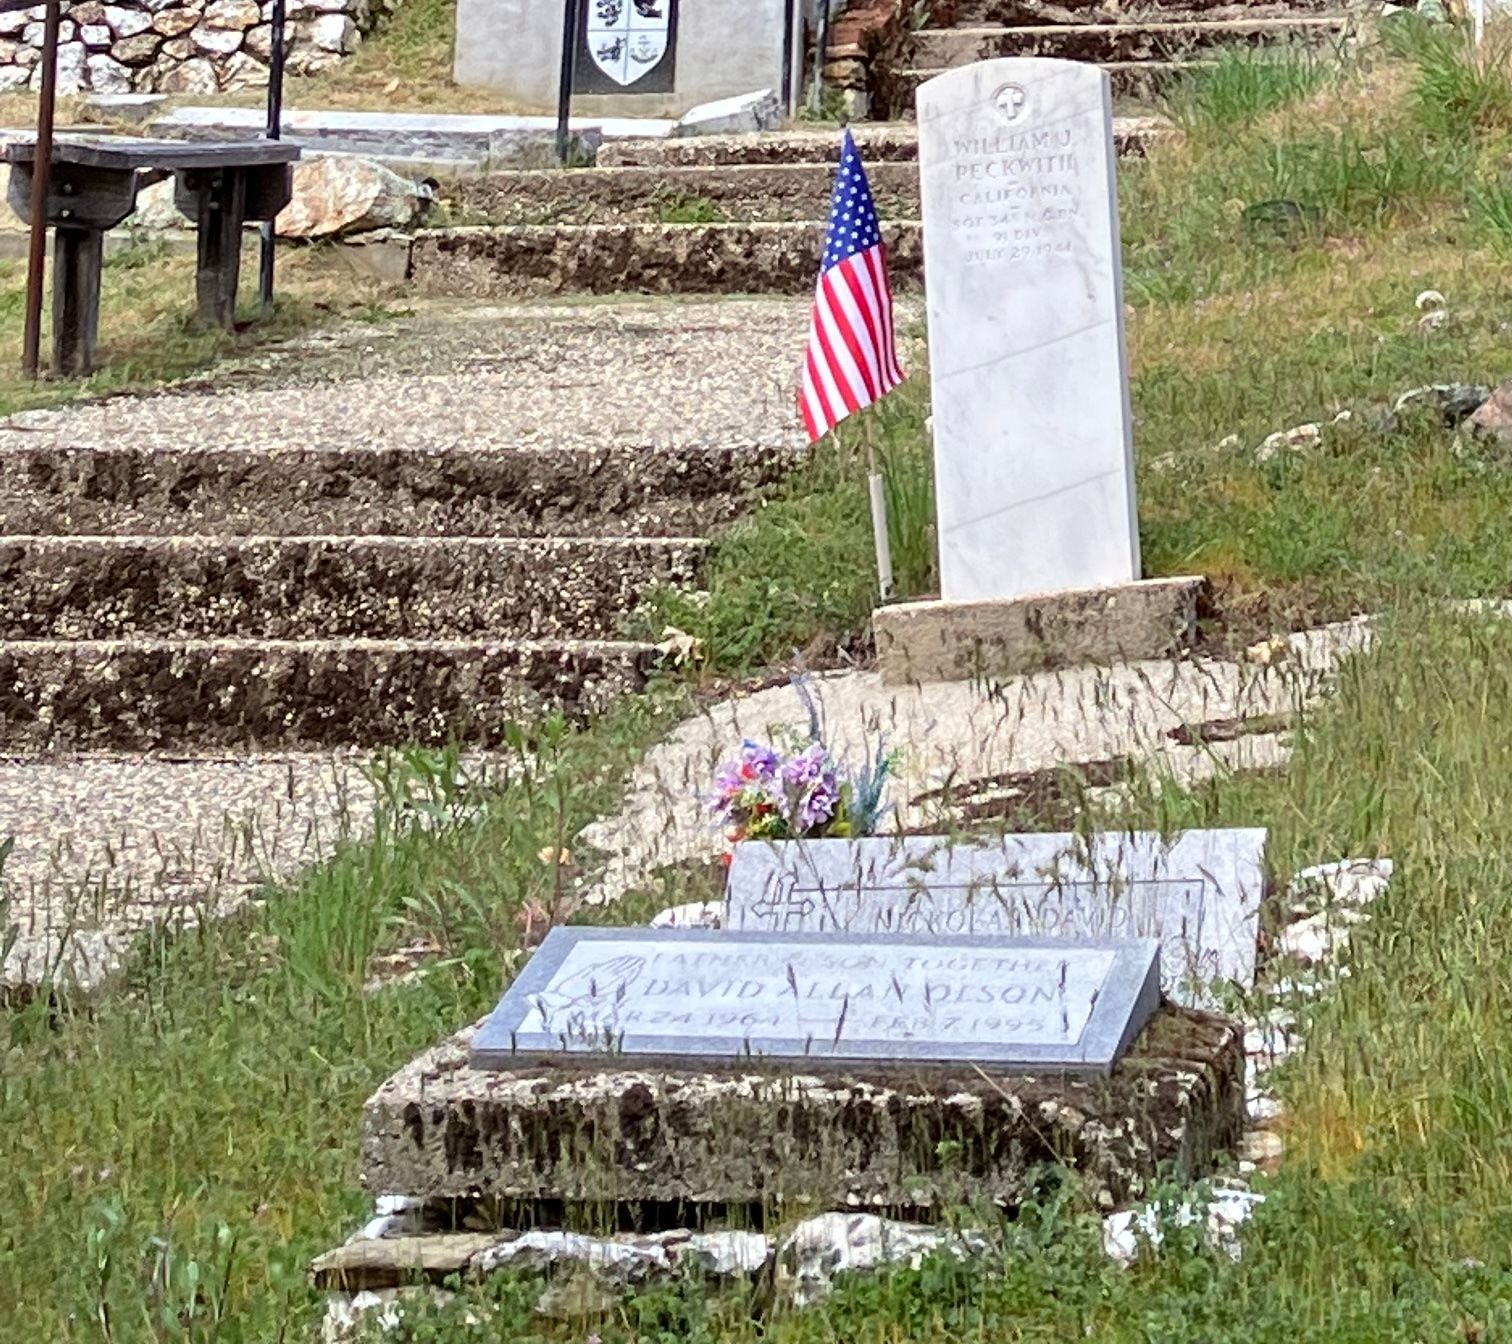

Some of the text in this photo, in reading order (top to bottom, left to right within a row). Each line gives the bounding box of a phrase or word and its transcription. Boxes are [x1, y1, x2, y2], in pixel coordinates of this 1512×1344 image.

[953, 131, 1050, 155] WILLIAM
[959, 184, 1072, 205] CALIFORNIA
[642, 979, 766, 999] DAVID
